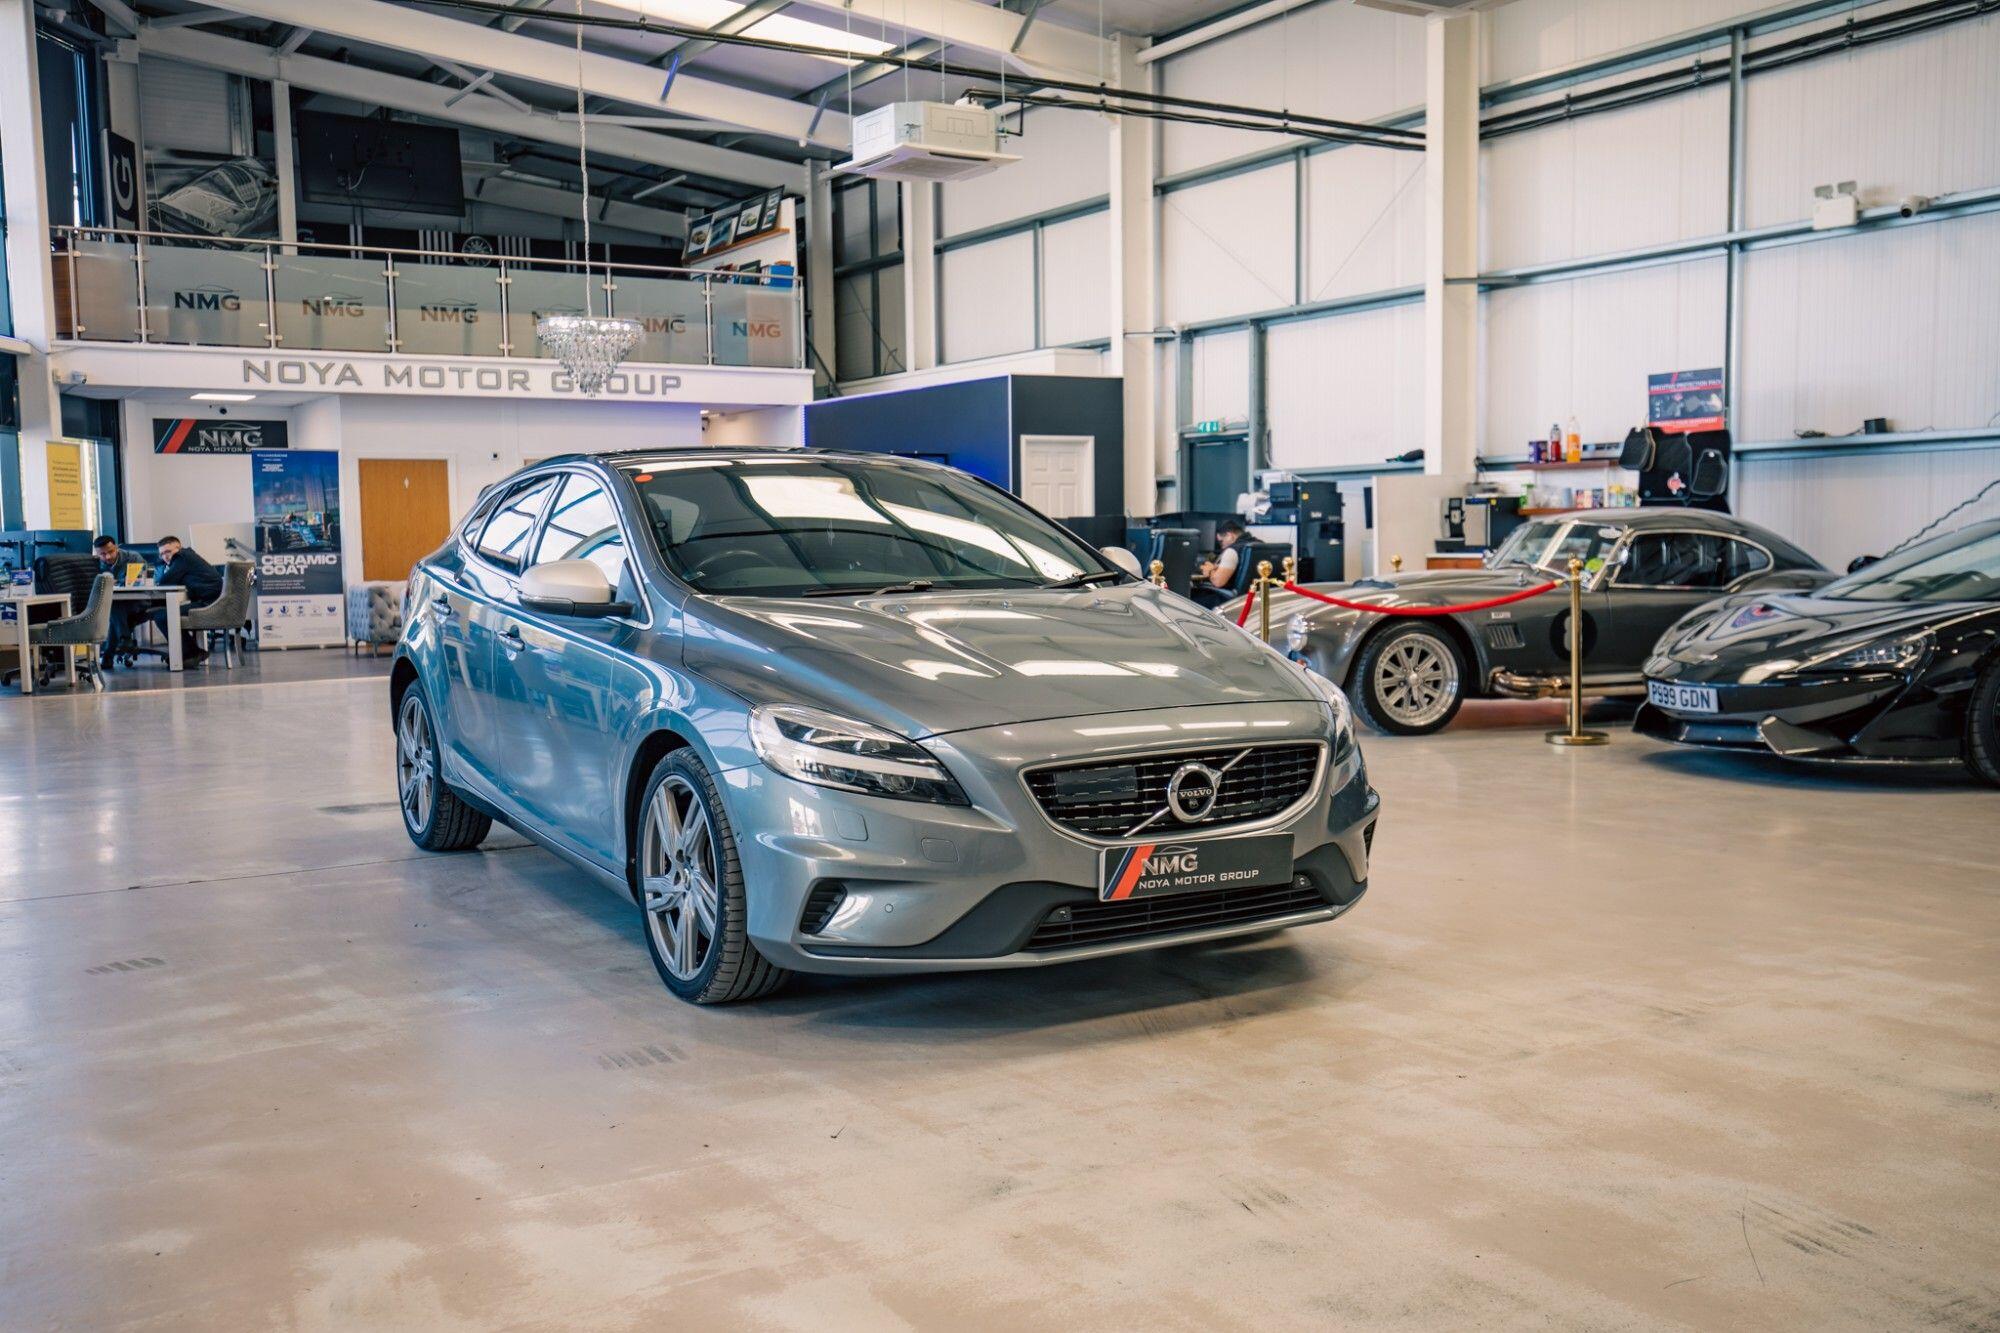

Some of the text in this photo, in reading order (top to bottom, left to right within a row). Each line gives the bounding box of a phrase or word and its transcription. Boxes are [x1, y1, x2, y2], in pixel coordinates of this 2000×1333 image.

[174, 292, 241, 311] NMG
[303, 299, 364, 317] NMG
[421, 306, 478, 323] NMG
[733, 321, 781, 338] NMG
[243, 359, 682, 395] NOYA MOTOR GOUP
[199, 430, 263, 447] NMG
[261, 554, 338, 566] CERAMIC
[261, 564, 309, 576] COAT
[1652, 684, 1711, 709] P999 GDN
[1179, 788, 1213, 798] VOLVO
[1140, 853, 1199, 877] NMG
[1139, 869, 1259, 889] NOYA MOTOR GROUP
